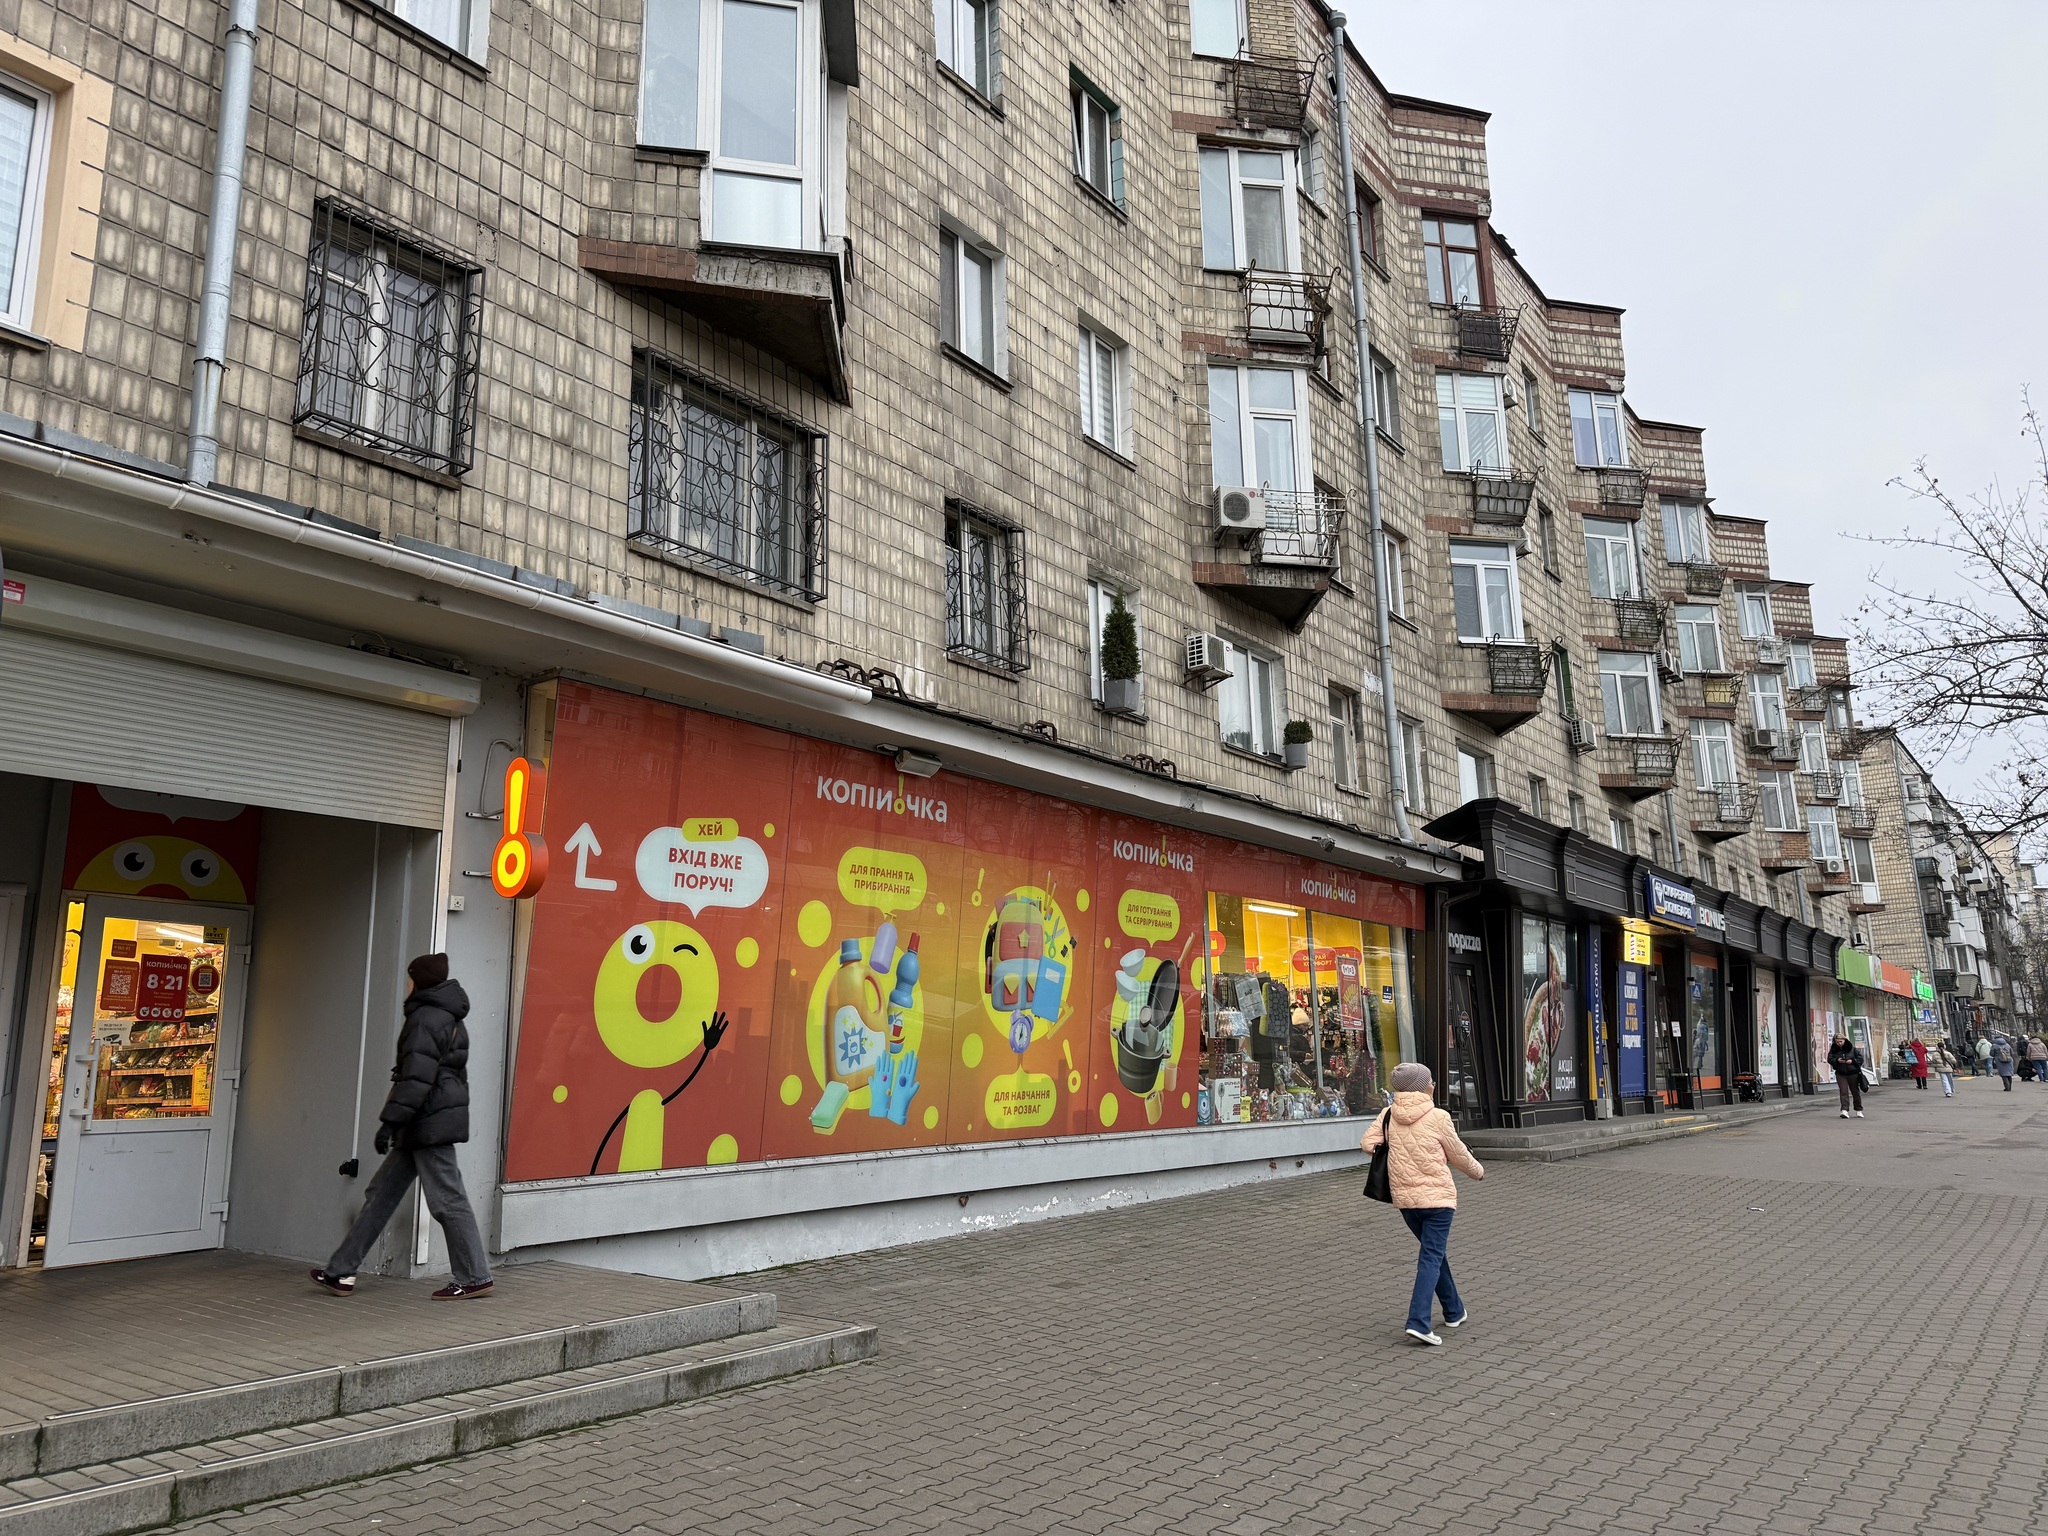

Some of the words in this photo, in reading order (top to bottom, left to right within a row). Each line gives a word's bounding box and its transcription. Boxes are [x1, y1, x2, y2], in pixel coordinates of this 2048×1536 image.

[698, 821, 723, 836] ХЕЙ
[668, 847, 706, 868] ВХІД
[710, 852, 743, 870] ВЖЕ
[850, 864, 867, 875] ДЛЯ
[870, 867, 903, 880] ПРАННЯ
[904, 871, 915, 881] ТА
[674, 872, 734, 893] ПОРУЧ!
[854, 879, 911, 895] ПРИБИРАННЯ
[1127, 904, 1139, 913] ДЛЯ
[1140, 906, 1171, 917] ГОТУВАННЯ
[1700, 906, 1725, 931] BONUS
[1125, 915, 1132, 924] ТА
[1133, 917, 1173, 929] СЕРВІРУВАННЯ
[1555, 1076, 1576, 1092] ЩОДНЯ
[993, 1092, 1010, 1103] ДЛЯ
[1011, 1090, 1050, 1101] НАВЧАННЯ
[1003, 1106, 1012, 1116] ТА
[1014, 1105, 1041, 1115] РОЗВАГ
